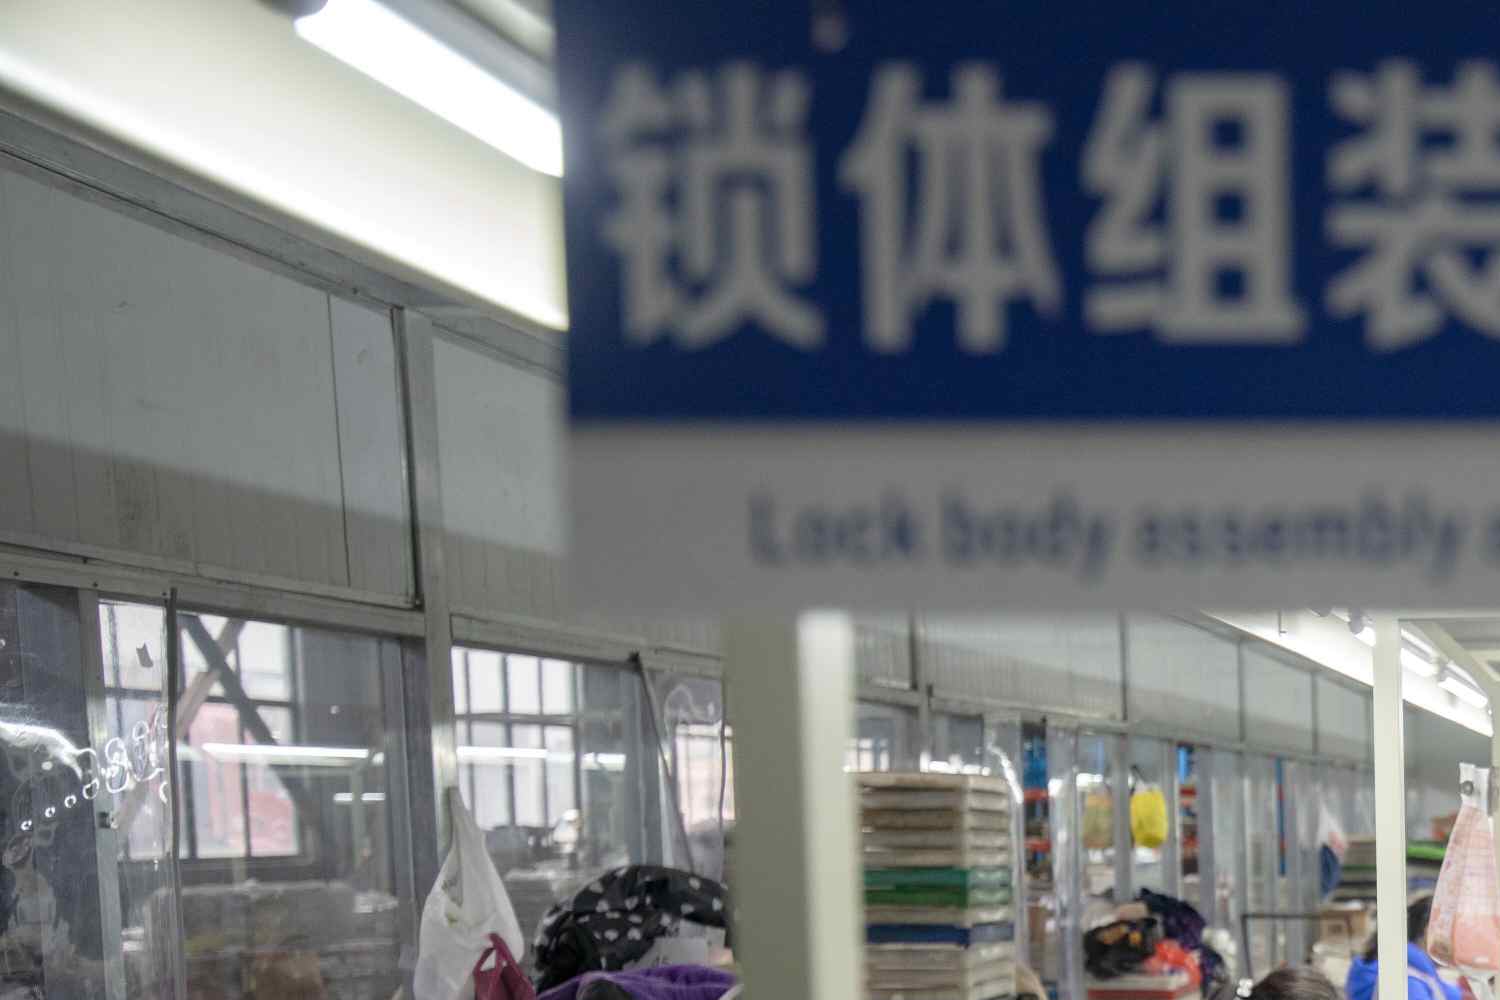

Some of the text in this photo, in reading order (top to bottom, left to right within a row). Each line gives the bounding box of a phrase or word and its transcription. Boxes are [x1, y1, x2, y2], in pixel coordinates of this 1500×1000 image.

[749, 488, 926, 566] Lock
[940, 488, 1112, 586] body
[1132, 488, 1471, 586] assembly
